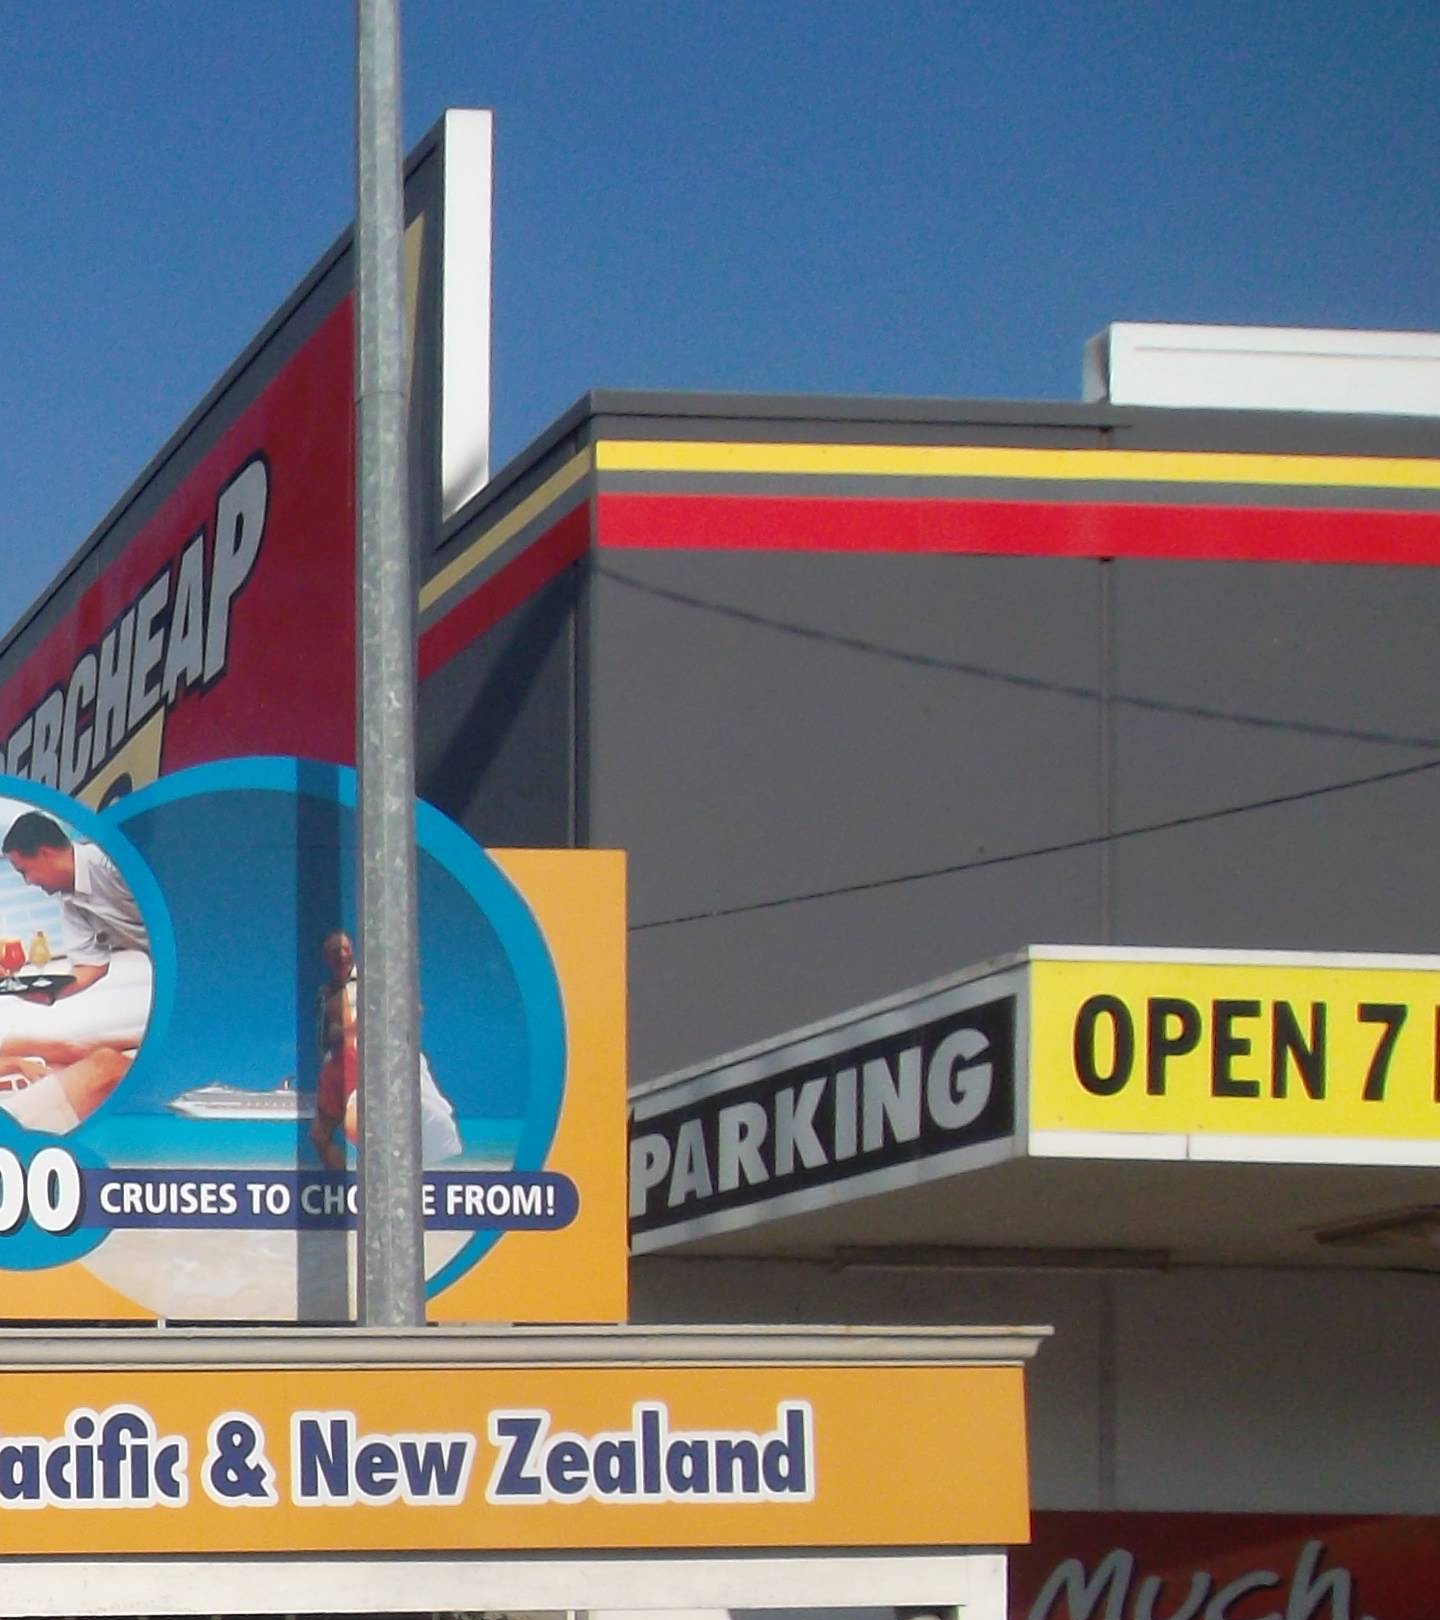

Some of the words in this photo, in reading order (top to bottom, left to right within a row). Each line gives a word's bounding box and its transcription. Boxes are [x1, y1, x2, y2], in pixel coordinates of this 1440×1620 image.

[1073, 994, 1327, 1099] OPEN
[1358, 1003, 1408, 1101] 7
[631, 1027, 994, 1215] PARKING
[100, 1182, 237, 1215] CRUISES
[248, 1184, 290, 1215] TO
[301, 1184, 436, 1216] CHE
[447, 1185, 555, 1216] FROM!
[211, 1419, 273, 1499] &
[298, 1420, 468, 1497] New
[497, 1410, 806, 1495] Zealand
